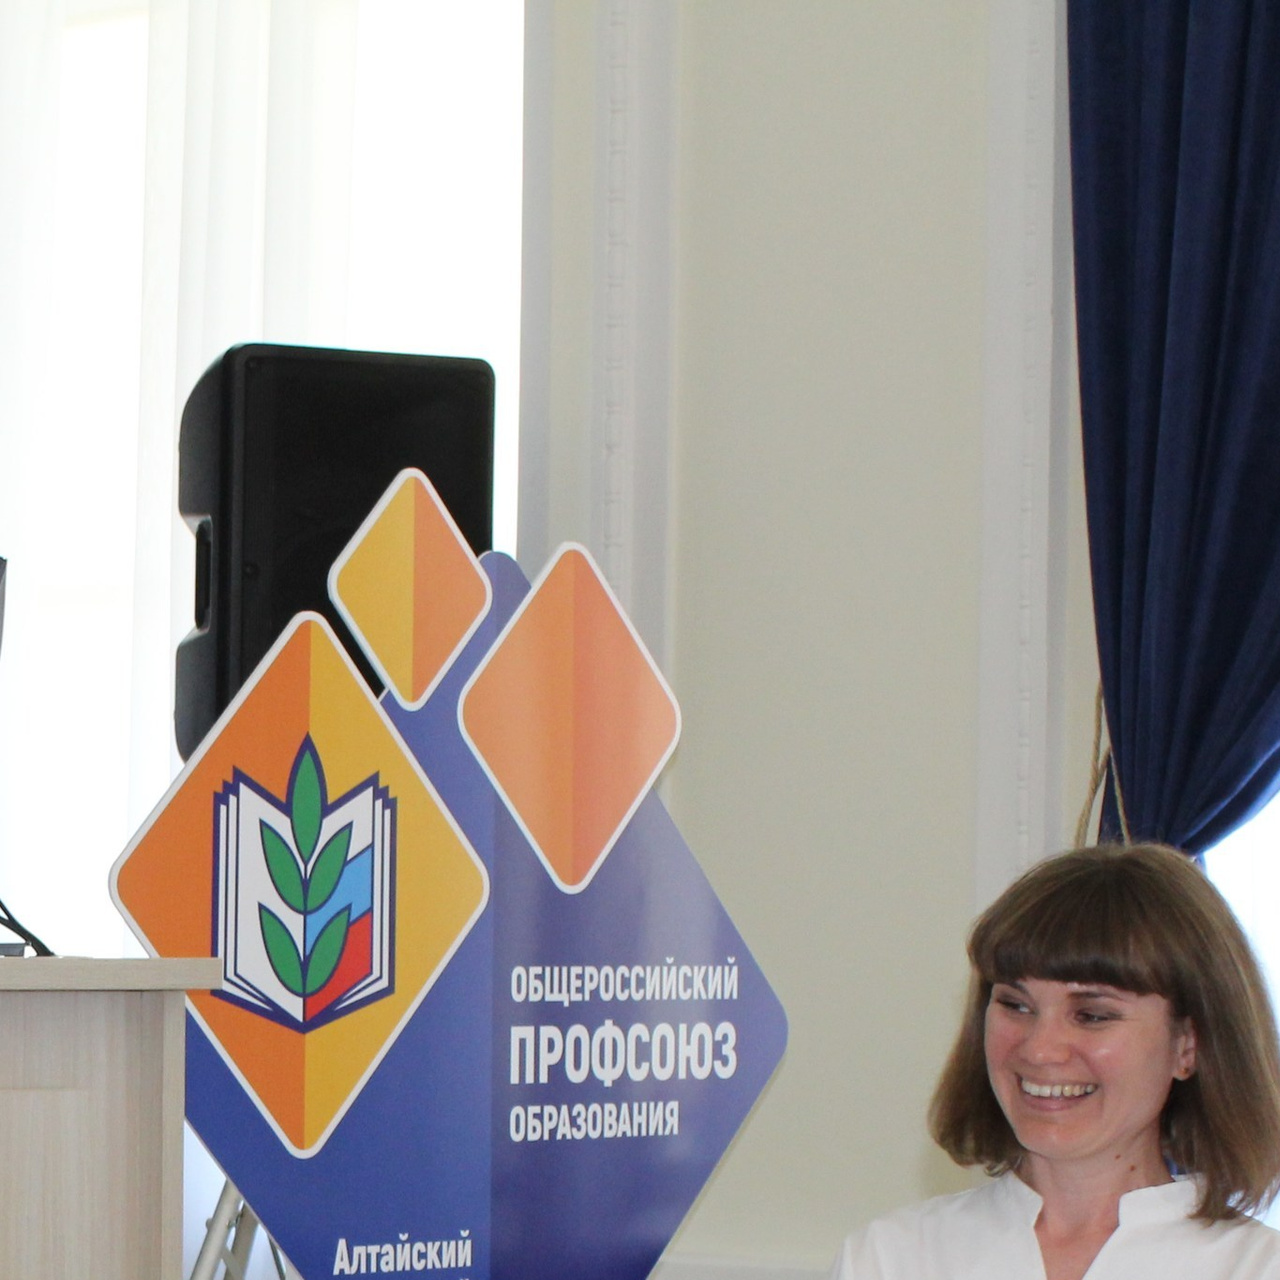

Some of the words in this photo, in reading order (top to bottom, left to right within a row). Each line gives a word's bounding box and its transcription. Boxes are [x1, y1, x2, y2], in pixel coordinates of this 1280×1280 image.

[510, 957, 739, 1007] ОБЩЕРОССИЙСКИЙ
[509, 1018, 738, 1087] ПРОФСОЮЗ
[509, 1101, 680, 1142] ОБРАЗОВАНИЯ
[333, 1230, 473, 1276] Алтайский
